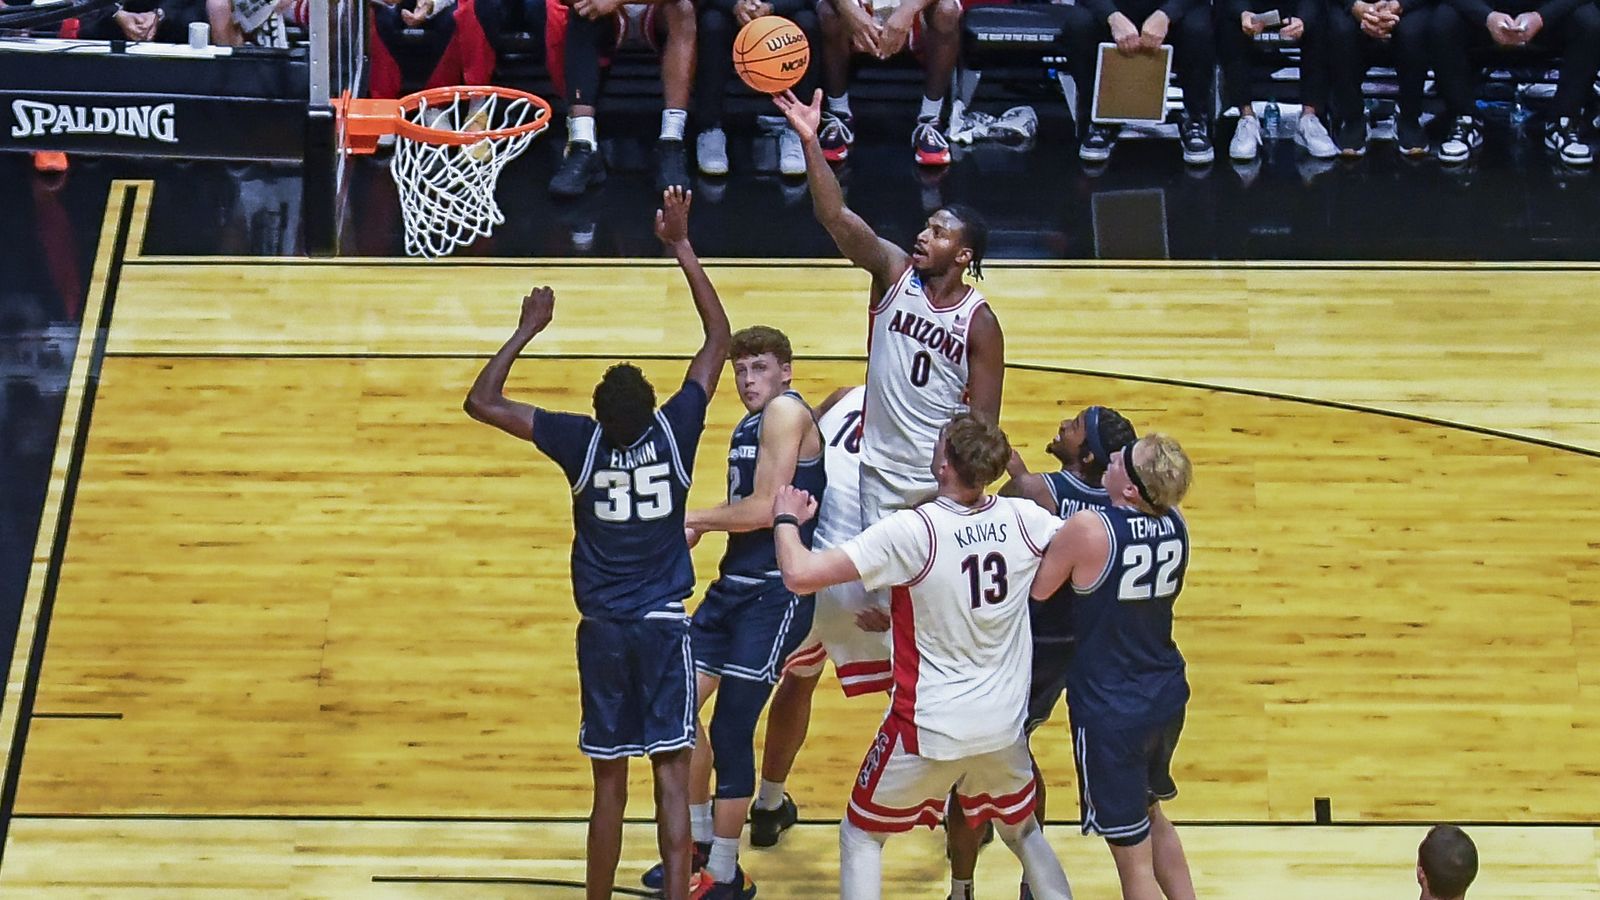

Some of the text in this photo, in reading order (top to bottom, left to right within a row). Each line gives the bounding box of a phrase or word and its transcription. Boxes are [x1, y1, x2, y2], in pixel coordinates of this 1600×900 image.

[11, 99, 179, 142] SPALDING
[888, 309, 964, 365] ARIZONA
[910, 351, 931, 387] 0
[593, 462, 672, 521] 35
[954, 522, 1007, 548] KRIVAS
[1127, 515, 1176, 540] TEMPLIN
[961, 551, 1009, 609] 13
[1117, 539, 1183, 601] 22
